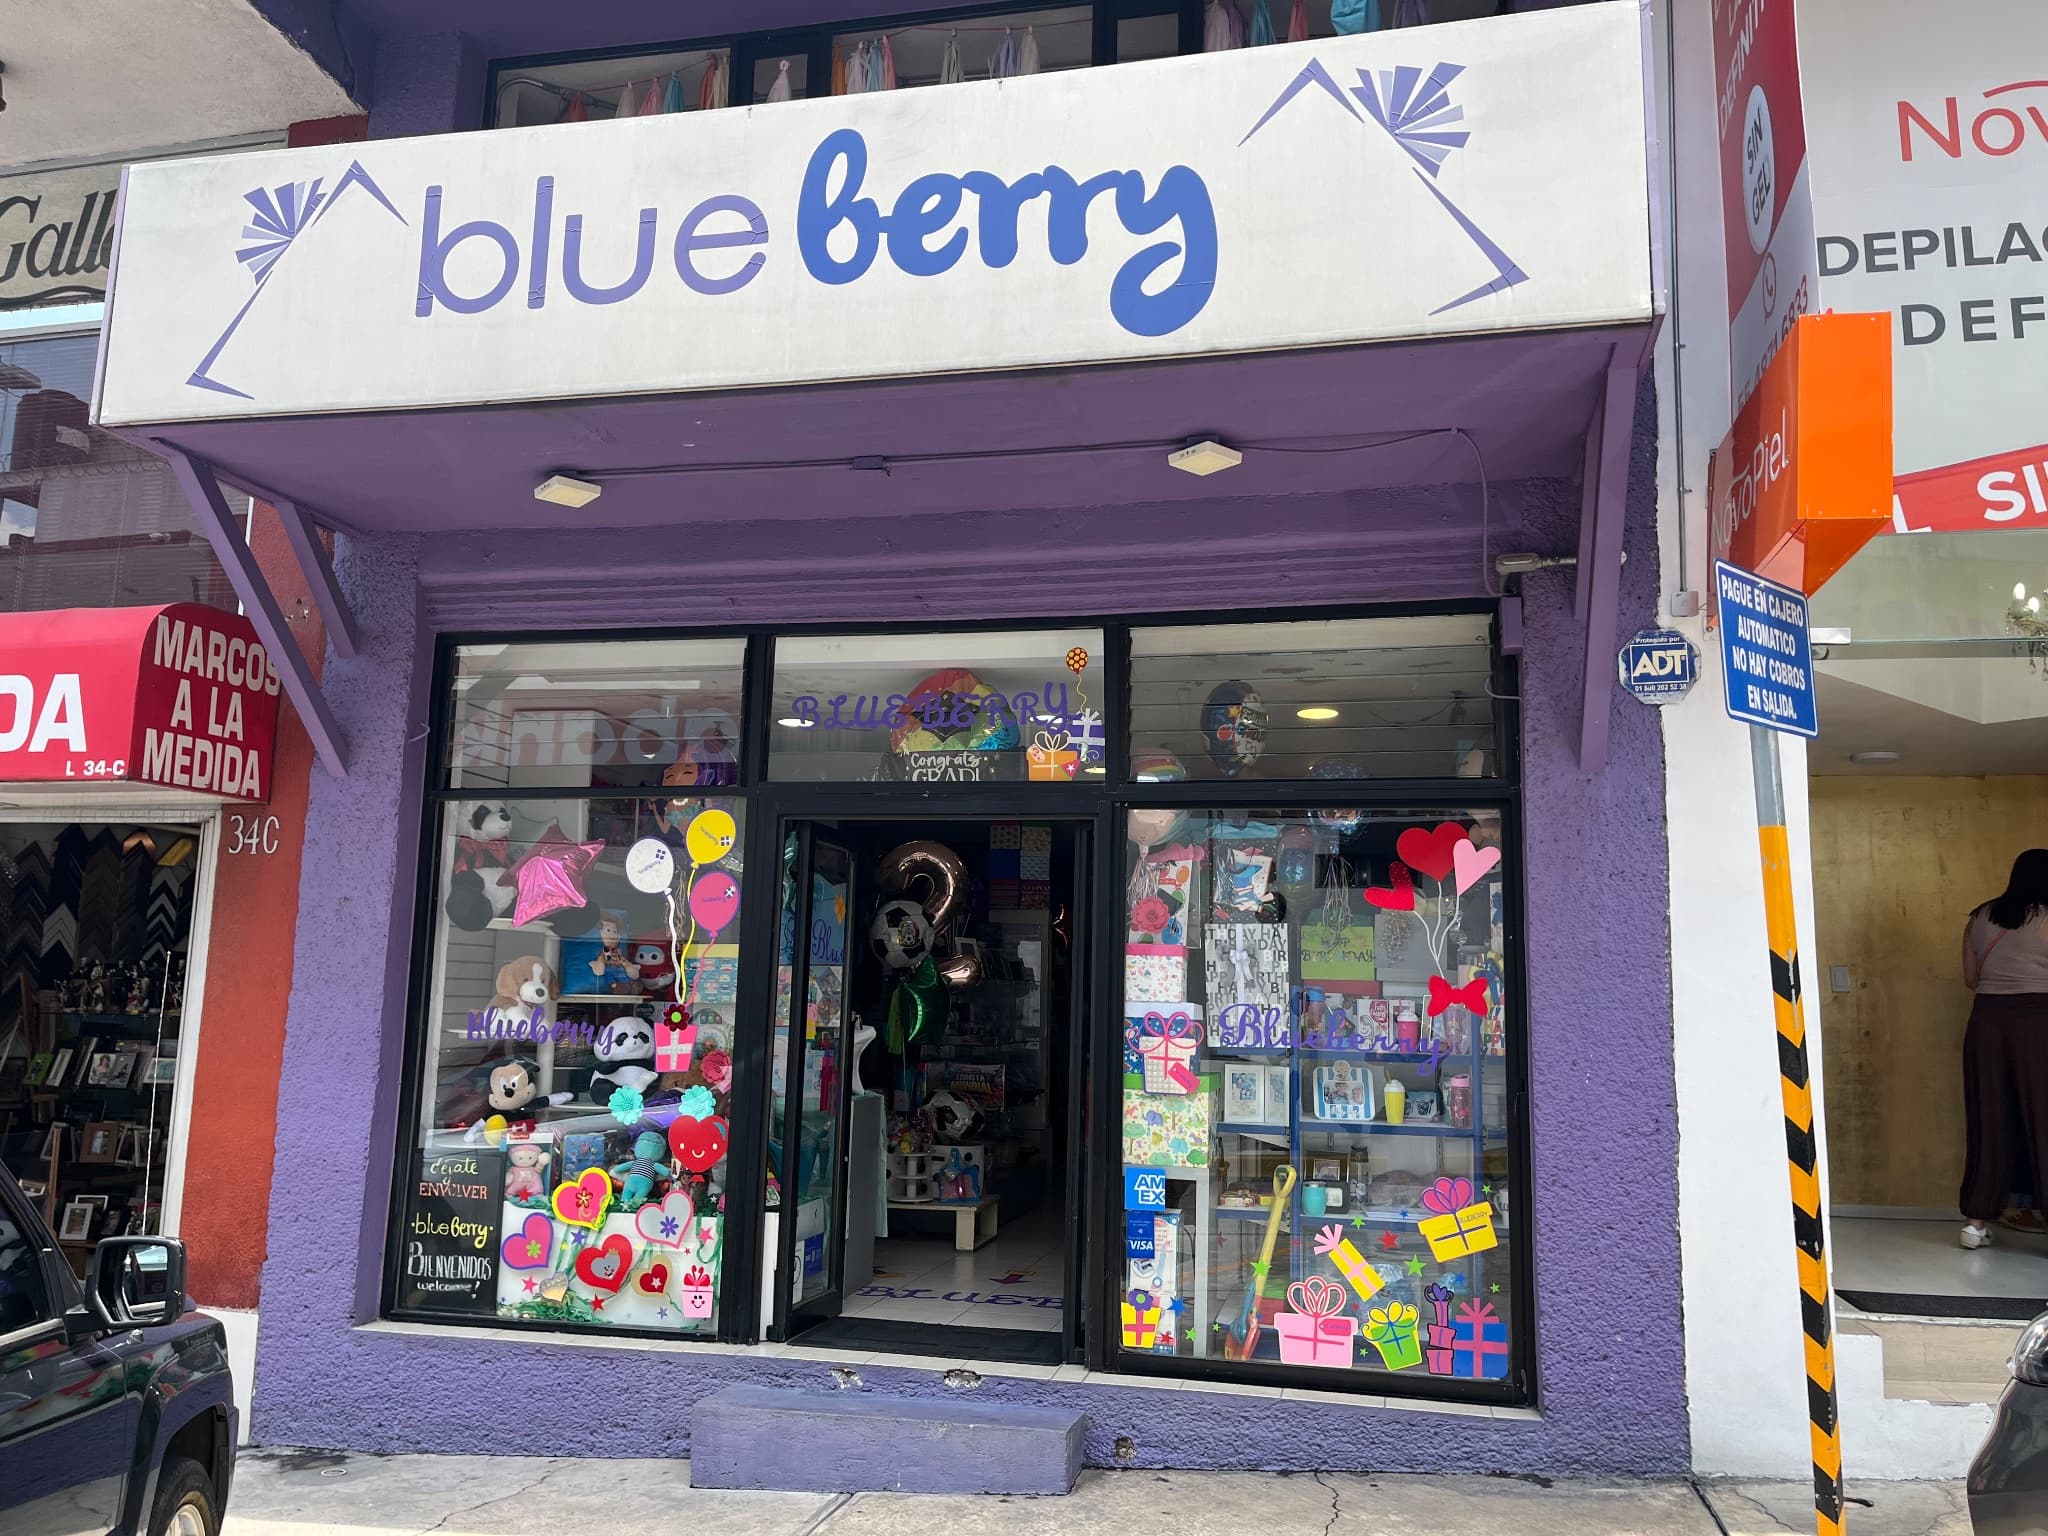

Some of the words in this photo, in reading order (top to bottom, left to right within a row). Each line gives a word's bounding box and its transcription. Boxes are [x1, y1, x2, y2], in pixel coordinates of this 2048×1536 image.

[1747, 106, 1763, 175] SIN
[1753, 162, 1771, 225] GEL
[1816, 222, 2048, 277] DEPILA
[1901, 296, 2046, 346] DEF
[1976, 461, 2048, 522] SI
[1721, 575, 1753, 609] PAGUE
[1754, 587, 1767, 613] EN
[1768, 594, 1804, 627] CAJERO
[154, 614, 281, 697] MARCOS
[1738, 614, 1796, 657] AUTOMATICO
[1633, 649, 1688, 677] ADT
[1732, 645, 1747, 672] NO
[1749, 651, 1768, 679] HAY
[1769, 658, 1806, 691] COBROS
[170, 678, 193, 731] A
[207, 686, 244, 742] LA
[1747, 684, 1761, 711] EN
[65, 760, 75, 777] L
[83, 759, 126, 777] 34-C
[141, 728, 261, 798] MEDIDA
[910, 751, 982, 773] Congrats
[228, 815, 280, 855] 34C
[467, 1005, 616, 1056] Blueberry
[1219, 1003, 1453, 1076] Blueberry
[1129, 1240, 1154, 1251] VISA
